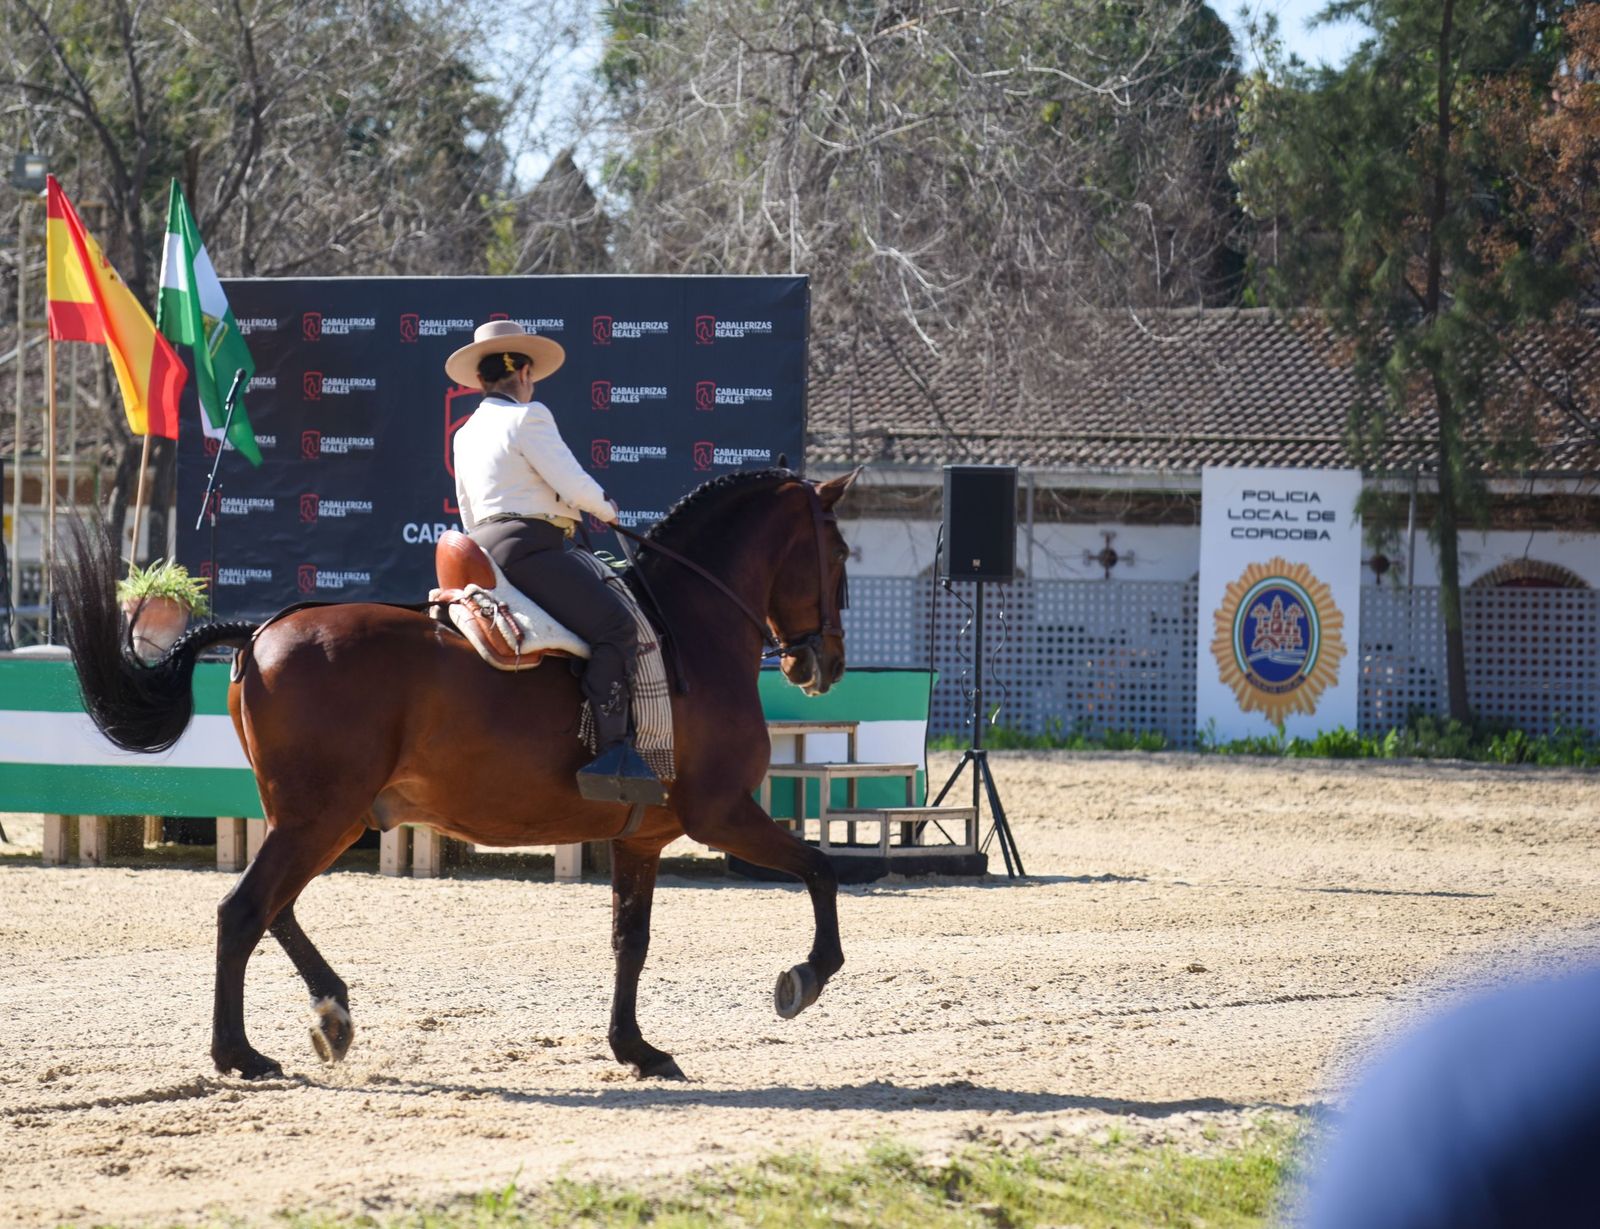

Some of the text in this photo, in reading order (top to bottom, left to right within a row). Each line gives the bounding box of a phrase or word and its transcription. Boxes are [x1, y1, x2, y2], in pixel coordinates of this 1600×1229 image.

[321, 318, 376, 326] CABALLERIZAS
[419, 319, 474, 328] CABALLERIZAS
[611, 321, 669, 330] CABALLERIZAS
[715, 321, 772, 330] CABALLERIZAS
[321, 326, 349, 334] REALES
[419, 327, 447, 336] REALES
[611, 329, 641, 338] REALES
[715, 329, 744, 338] REALES
[322, 378, 376, 387] CABALLERIZAS
[322, 385, 350, 394] REALES
[611, 386, 667, 395] CABALLERIZAS
[715, 387, 772, 397] CABALLERIZAS
[611, 394, 640, 403] REALES
[715, 395, 744, 404] REALES
[320, 436, 375, 446] CABALLERIZAS
[320, 444, 348, 453] REALES
[610, 446, 667, 455] CABALLERIZAS
[713, 448, 771, 458] CABALLERIZAS
[610, 453, 639, 462] REALES
[713, 456, 743, 465] REALES
[1242, 490, 1321, 502] POLICIA
[220, 498, 275, 507] CABALLERIZAS
[318, 501, 373, 510] CABALLERIZAS
[220, 505, 248, 514] REALES
[318, 508, 346, 517] REALES
[617, 511, 665, 520] BALLERIZAS
[1227, 508, 1336, 522] LOCAL DE
[1230, 527, 1331, 541] CORDOBA
[218, 568, 272, 578] CABALLERIZAS
[316, 571, 370, 581] CABALLERIZAS
[218, 576, 246, 585] REALES
[316, 578, 344, 588] REALES
